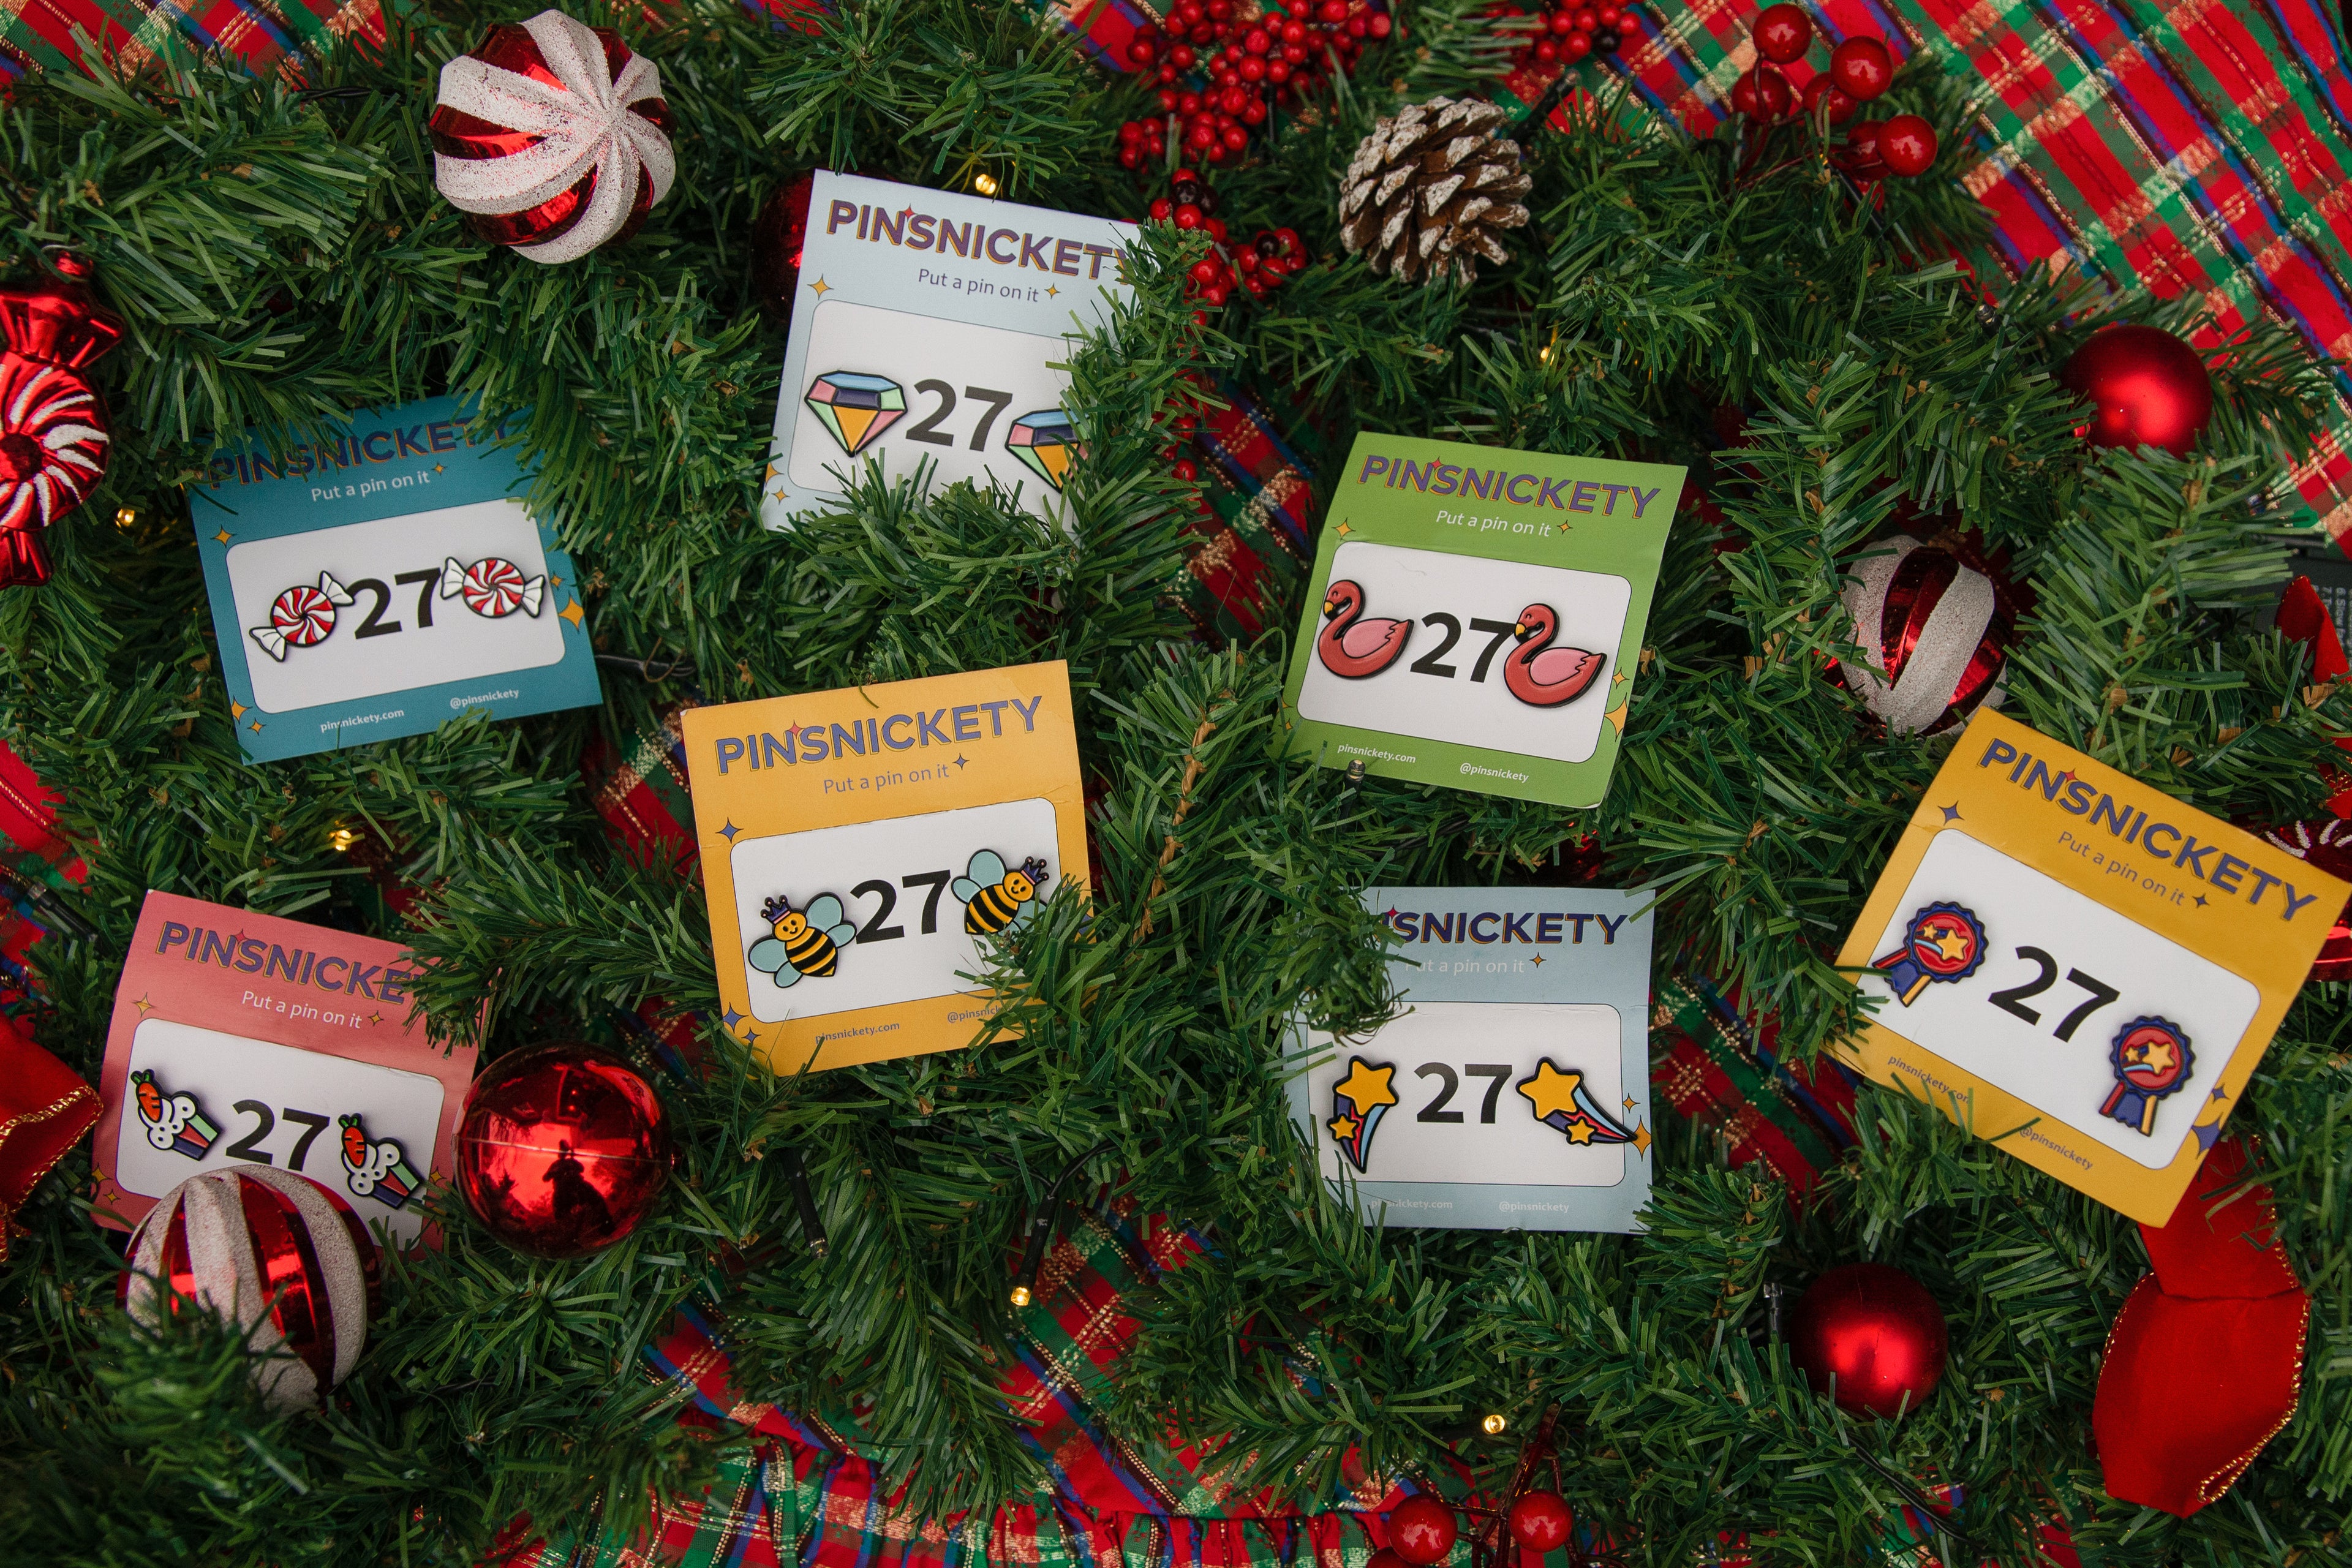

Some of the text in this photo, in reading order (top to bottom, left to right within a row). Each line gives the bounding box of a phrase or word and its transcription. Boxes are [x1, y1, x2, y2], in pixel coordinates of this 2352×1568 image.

[918, 268, 1039, 303] Put a pin on it
[905, 379, 1013, 452] 27
[311, 470, 430, 502] Put a pin on it
[1357, 454, 1661, 519] PINSNICKETY
[1435, 510, 1551, 537] Put a pin on it
[347, 567, 442, 640] 27
[1409, 612, 1516, 683] 27
[450, 688, 519, 710] @pinsnickety
[715, 696, 1042, 776] PINSNICKETY
[1337, 743, 1529, 783] pinsnickety.com @pinsnickety
[823, 764, 949, 794] Put a pin on it
[1977, 737, 2318, 921] PINSNICKETY
[2058, 831, 2186, 907] Put a pin on it
[850, 869, 952, 945] 27
[155, 921, 423, 1006] PINSNICKE
[1439, 961, 1448, 973] a
[1453, 959, 1480, 976] pin
[1485, 960, 1508, 973] on
[1513, 959, 1525, 973] it
[1988, 946, 2120, 1043] 27
[241, 990, 362, 1030] Put a pin on it
[947, 1005, 1001, 1024] @pinsnick
[1414, 1062, 1512, 1125] 27
[225, 1099, 331, 1172] 27
[2019, 1126, 2093, 1170] @pinsnickety
[1371, 1199, 1570, 1214] pisnickety.com @pinsnickety
